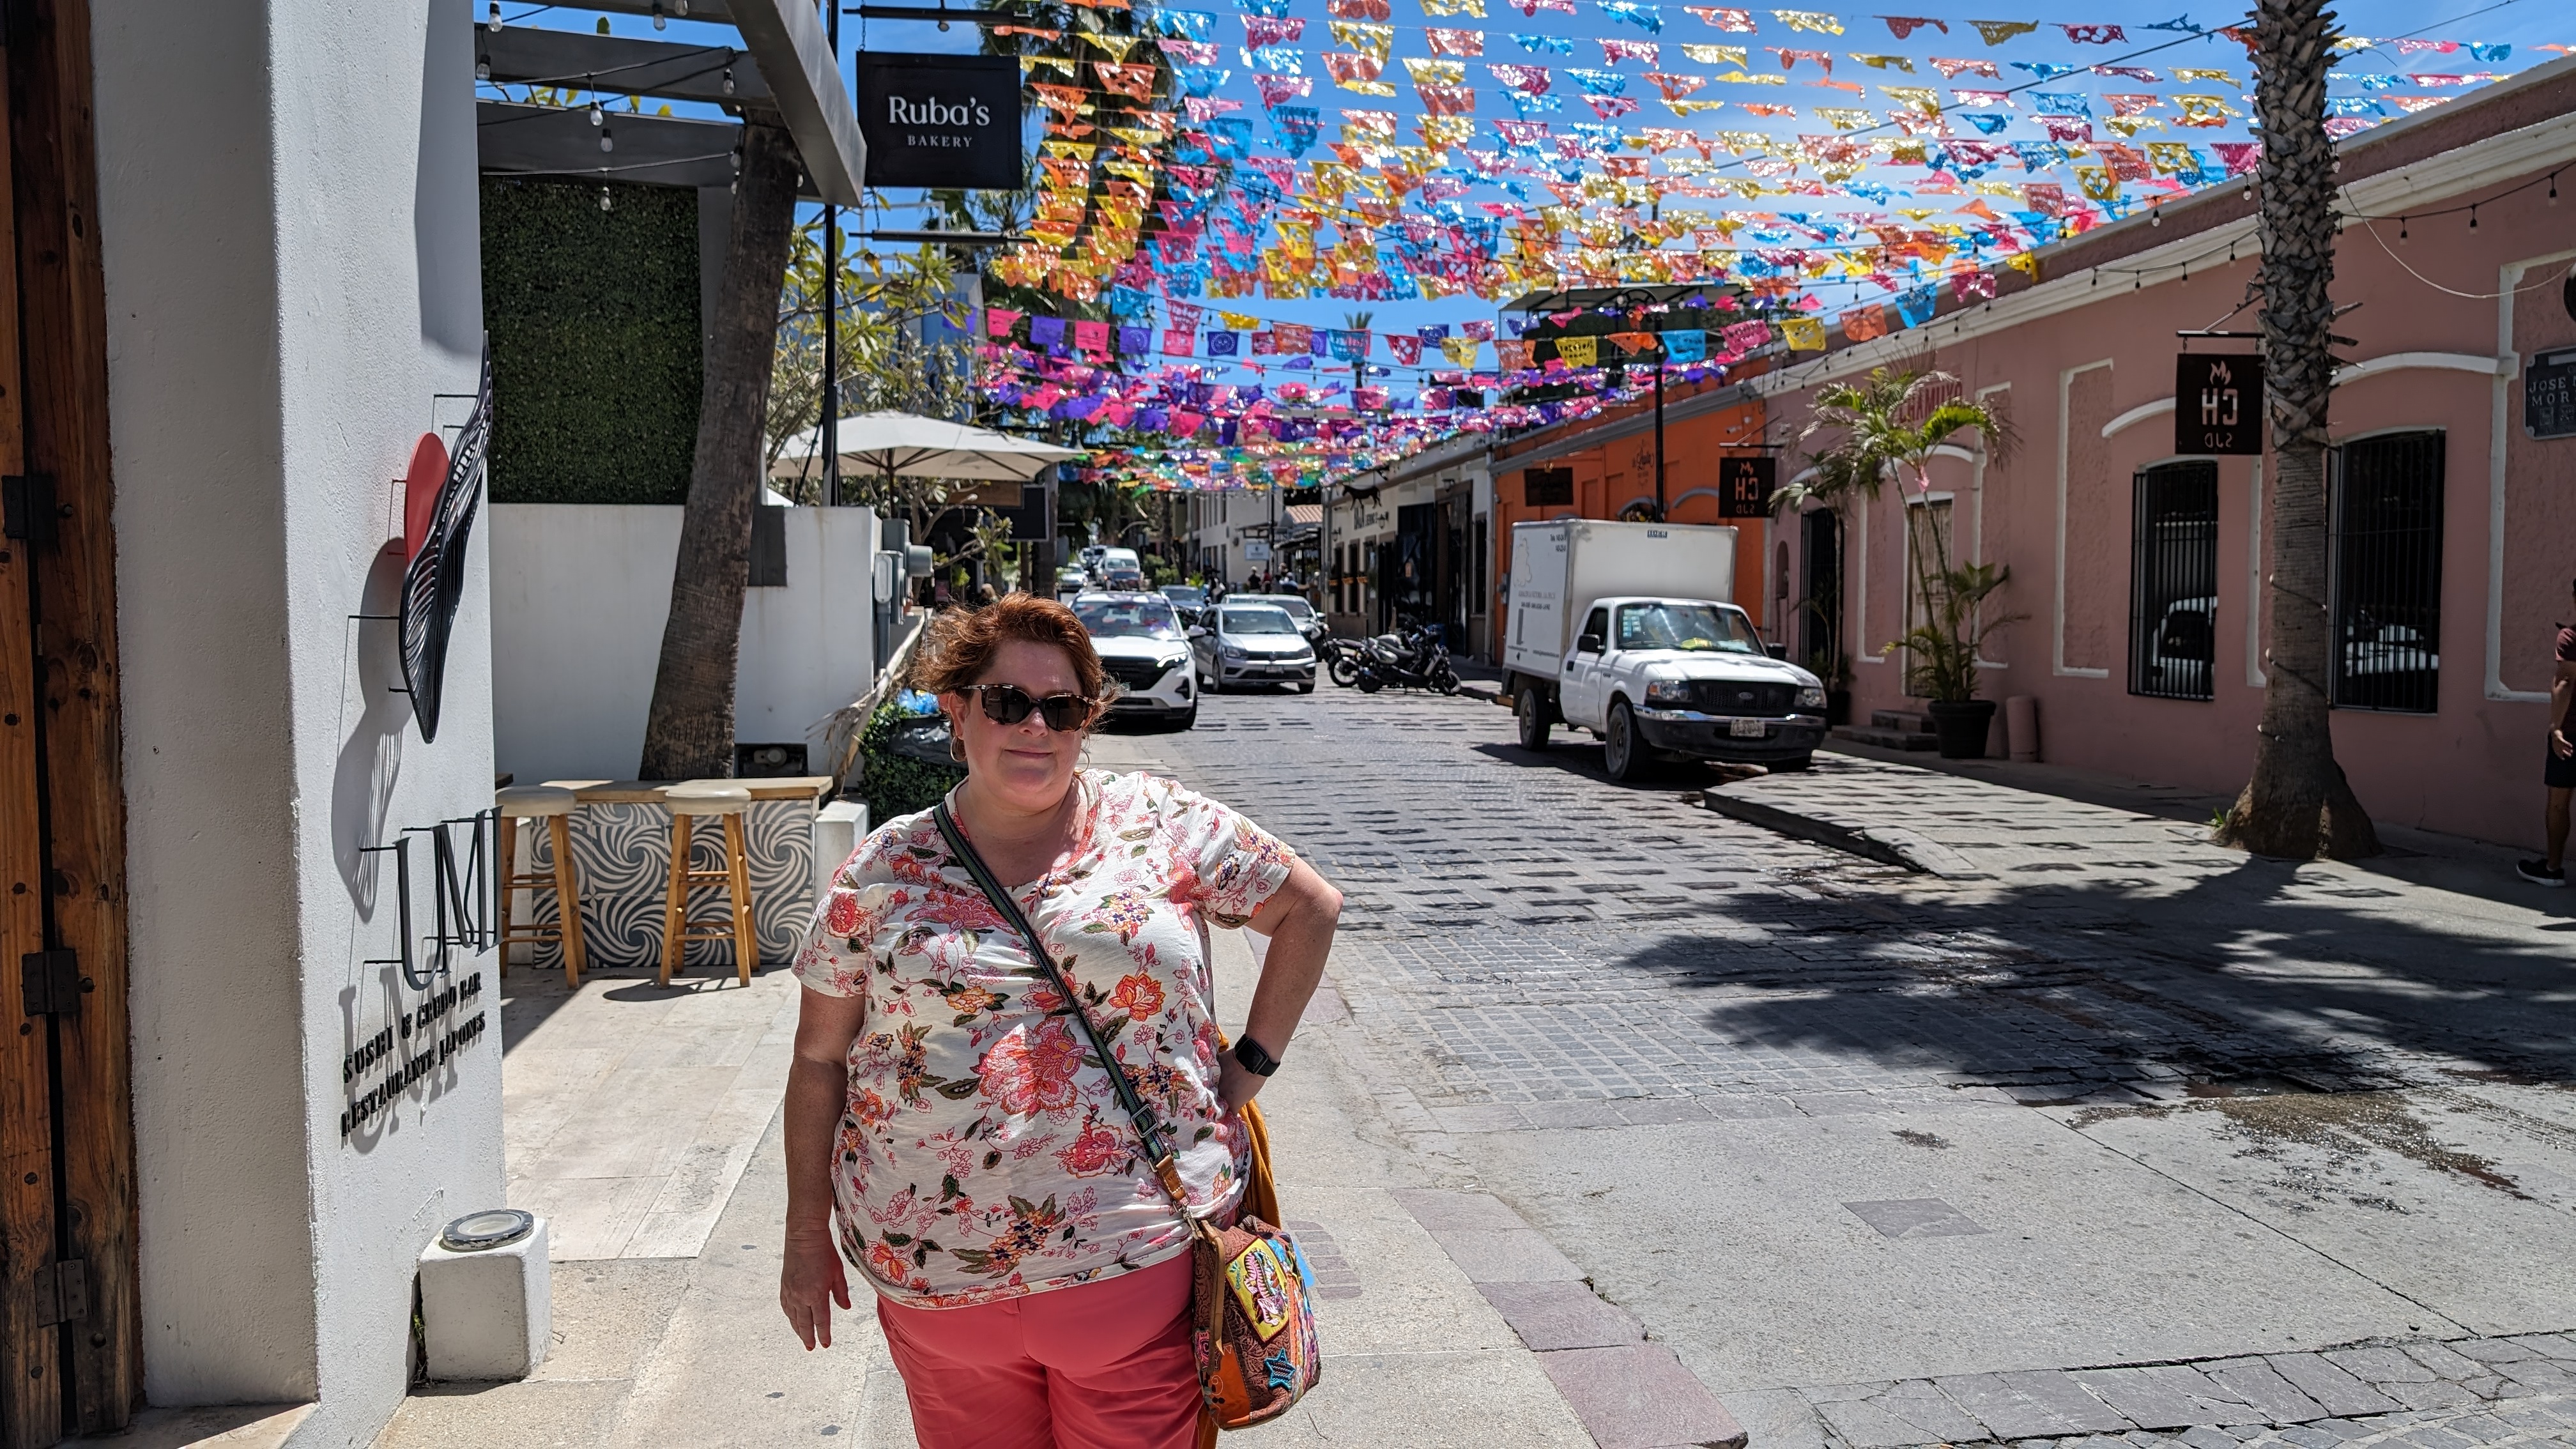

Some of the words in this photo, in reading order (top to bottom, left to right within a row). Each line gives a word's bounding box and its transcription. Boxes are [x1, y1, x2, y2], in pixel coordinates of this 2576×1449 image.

[888, 96, 990, 126] Ruba's
[907, 134, 972, 148] BAKERY
[2529, 376, 2566, 394] JOSE
[2531, 390, 2575, 406] MOR
[392, 804, 505, 991] UMI
[343, 1025, 394, 1084] SUSHI
[401, 1013, 413, 1039] &
[459, 971, 482, 1002] BAR
[341, 1045, 435, 1137] RESTAURANTE
